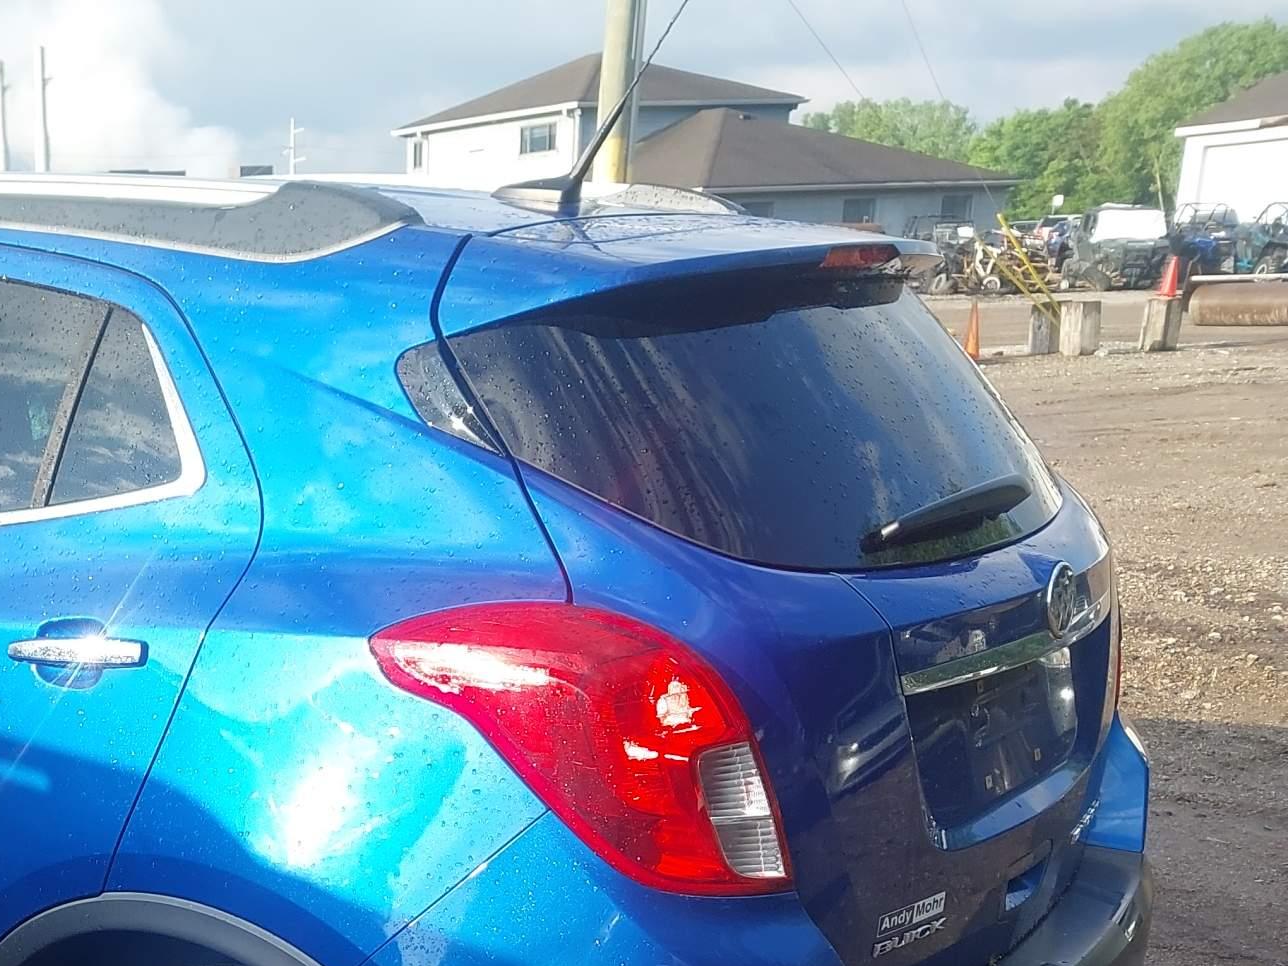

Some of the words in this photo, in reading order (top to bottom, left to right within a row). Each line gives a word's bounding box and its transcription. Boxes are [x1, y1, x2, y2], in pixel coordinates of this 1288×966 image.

[880, 910, 913, 931] Andy
[915, 896, 944, 917] Mohr
[872, 917, 947, 959] BUICK
